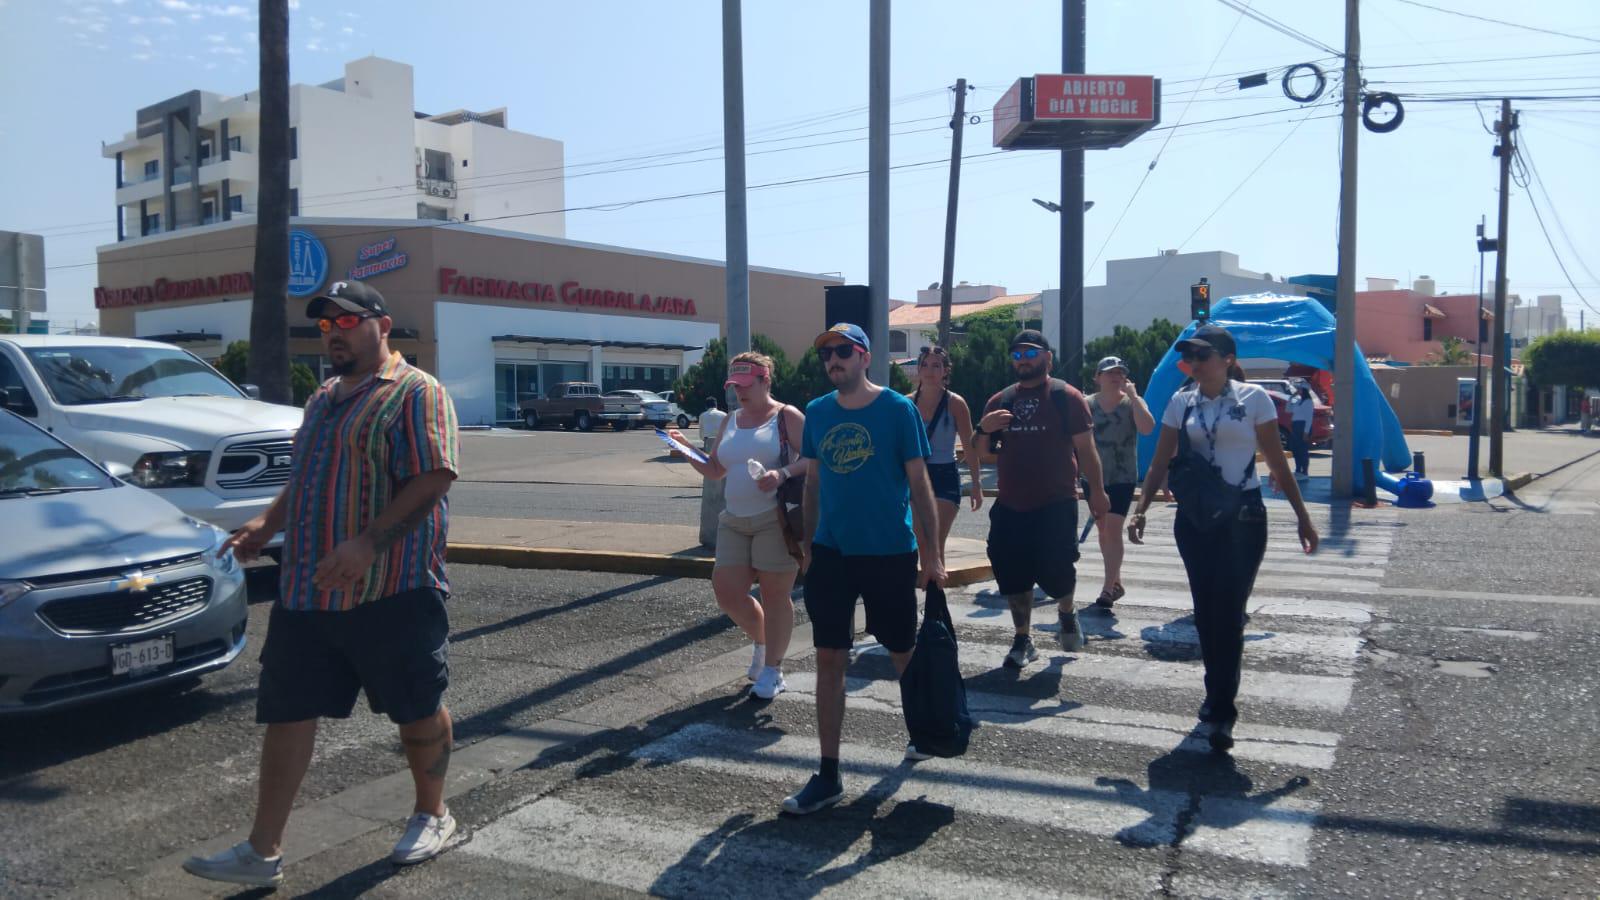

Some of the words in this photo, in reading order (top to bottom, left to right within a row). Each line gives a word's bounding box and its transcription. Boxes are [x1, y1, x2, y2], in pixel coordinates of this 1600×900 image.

[1063, 79, 1125, 96] ABIERTO
[1078, 98, 1087, 113] Y
[1090, 99, 1138, 114] NOCHE
[439, 267, 557, 302] FARMACIA
[560, 280, 697, 315] GUADALAJARA
[1199, 286, 1208, 299] 9
